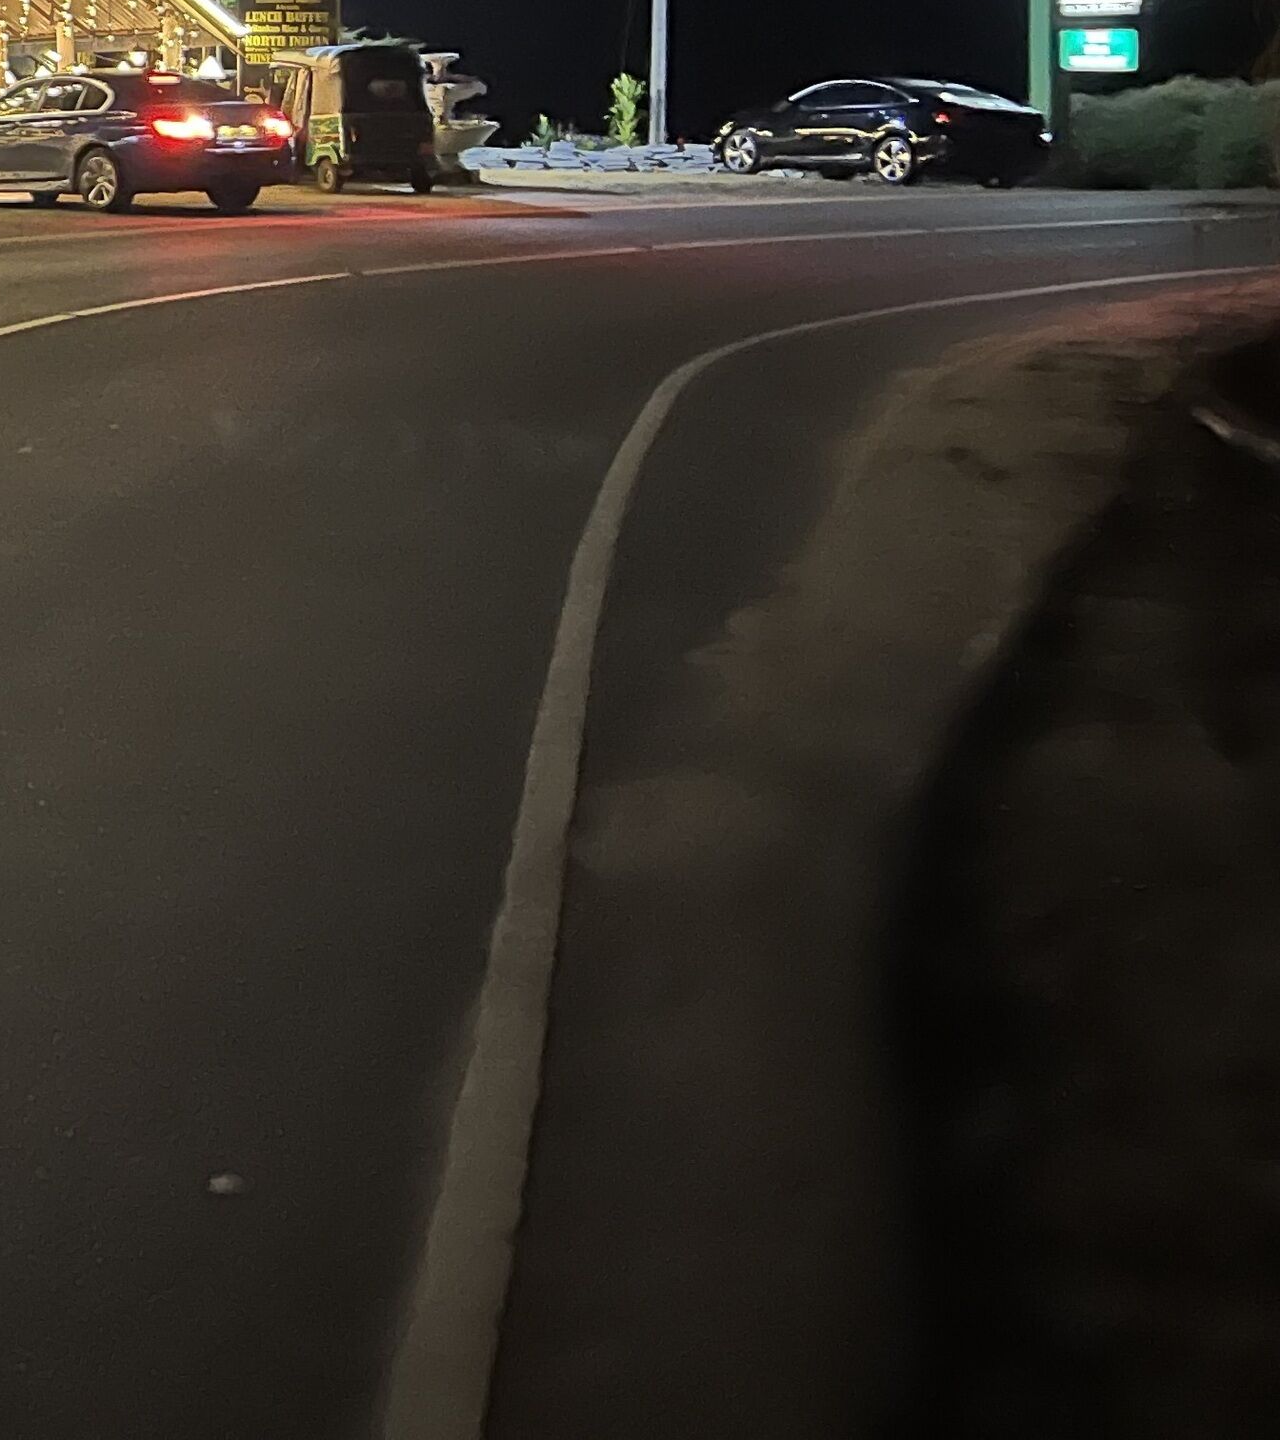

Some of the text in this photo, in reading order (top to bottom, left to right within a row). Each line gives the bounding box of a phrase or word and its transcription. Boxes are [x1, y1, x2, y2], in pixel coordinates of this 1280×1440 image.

[245, 11, 283, 23] LUNCH
[244, 35, 330, 47] NORTH INDIAN
